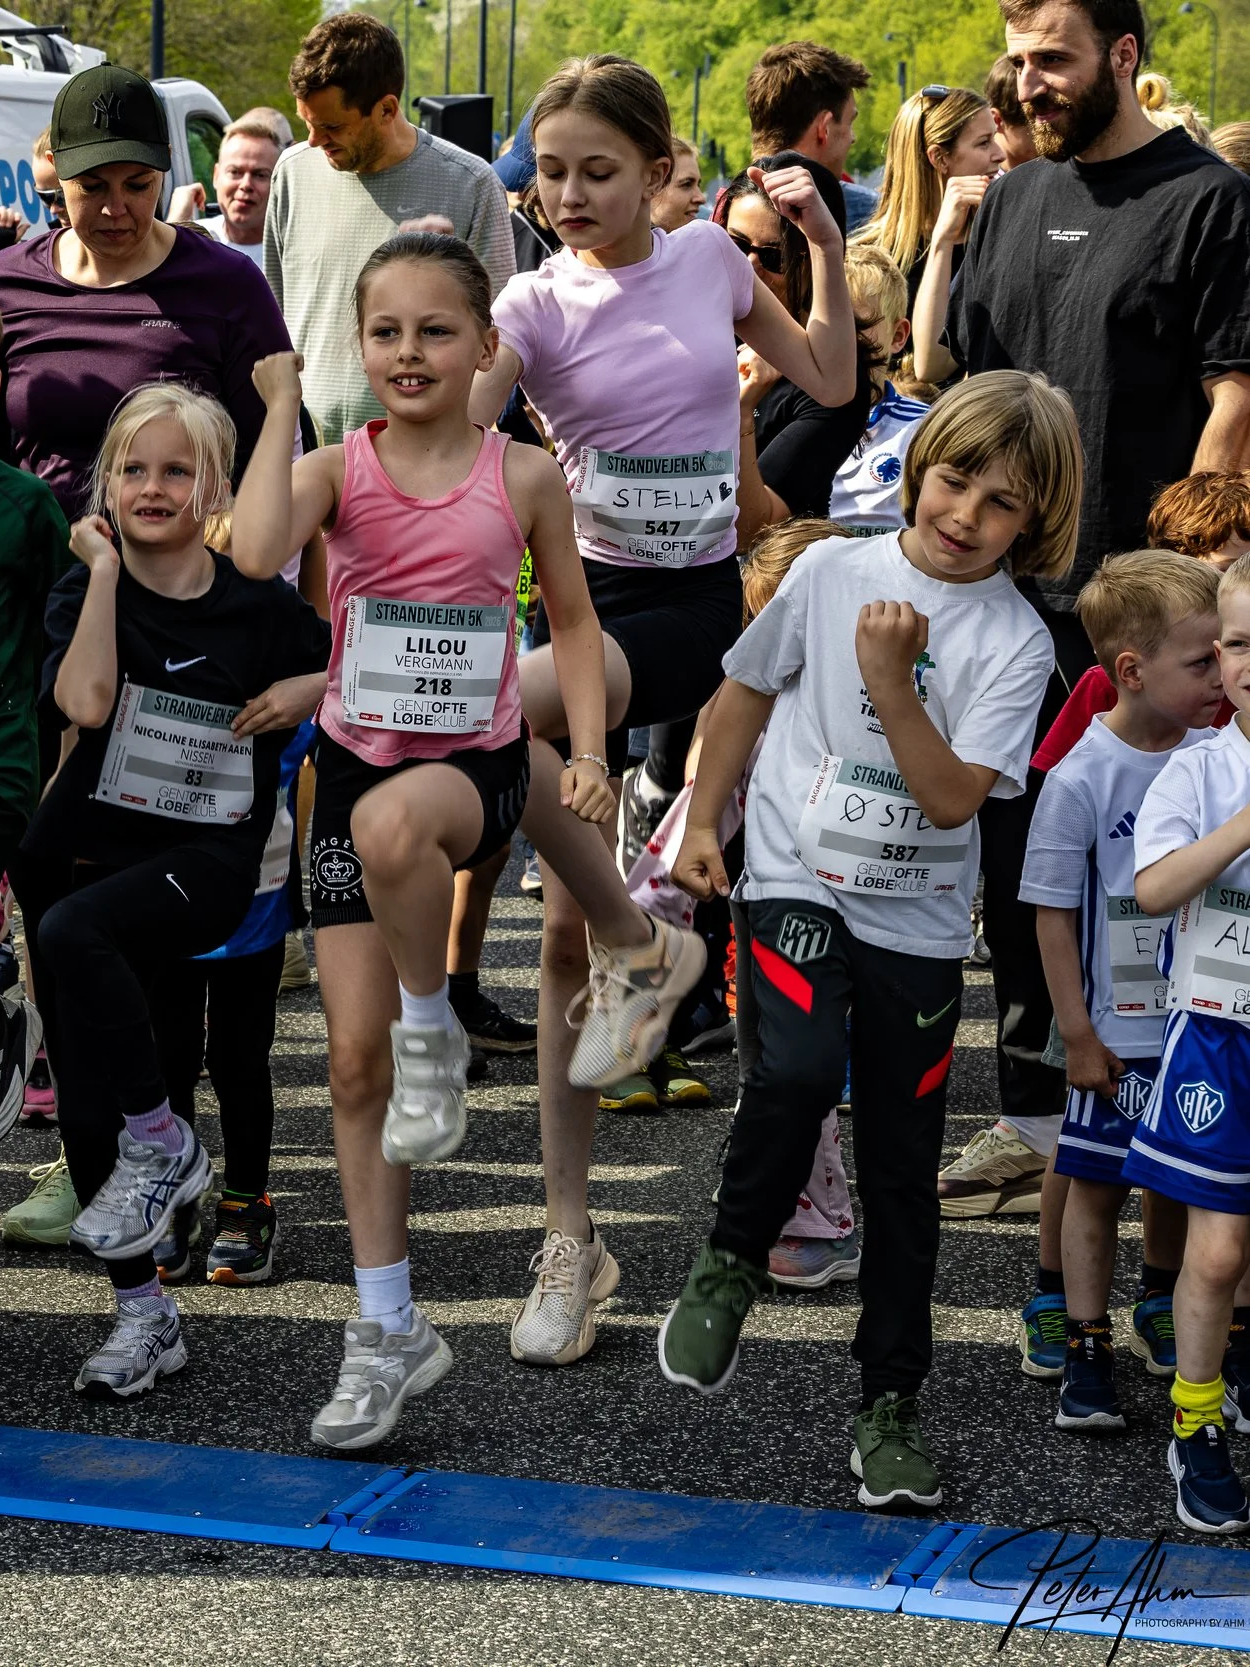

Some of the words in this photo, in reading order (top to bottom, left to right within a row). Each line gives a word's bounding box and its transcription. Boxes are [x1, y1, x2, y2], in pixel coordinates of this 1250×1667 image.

[607, 456, 689, 474] STRANDVEJEN
[692, 456, 707, 472] 5K
[613, 488, 714, 509] STELLA
[645, 521, 680, 536] 547
[627, 537, 697, 551] GENTOFTE
[375, 603, 465, 626] STRANDVEJEN
[468, 610, 483, 627] 5K
[406, 636, 466, 656] LILOU
[395, 655, 473, 671] VERGMANN
[414, 677, 452, 696] 218
[154, 695, 225, 723] STRANDVEJEN
[393, 699, 467, 715] GENTOFTE
[393, 712, 466, 728] LØBEKLUB
[134, 725, 186, 745] NICOLINE
[189, 738, 227, 753] ELISABETH
[228, 744, 252, 756] AAEN
[181, 749, 214, 764] NISSEN
[185, 770, 203, 786] 83
[158, 786, 216, 805] GENTOFTE
[156, 798, 217, 817] LØBEKLUB
[880, 843, 919, 862] 587
[856, 862, 930, 880] GENTOFTE
[854, 875, 927, 892] LØBEKLUB
